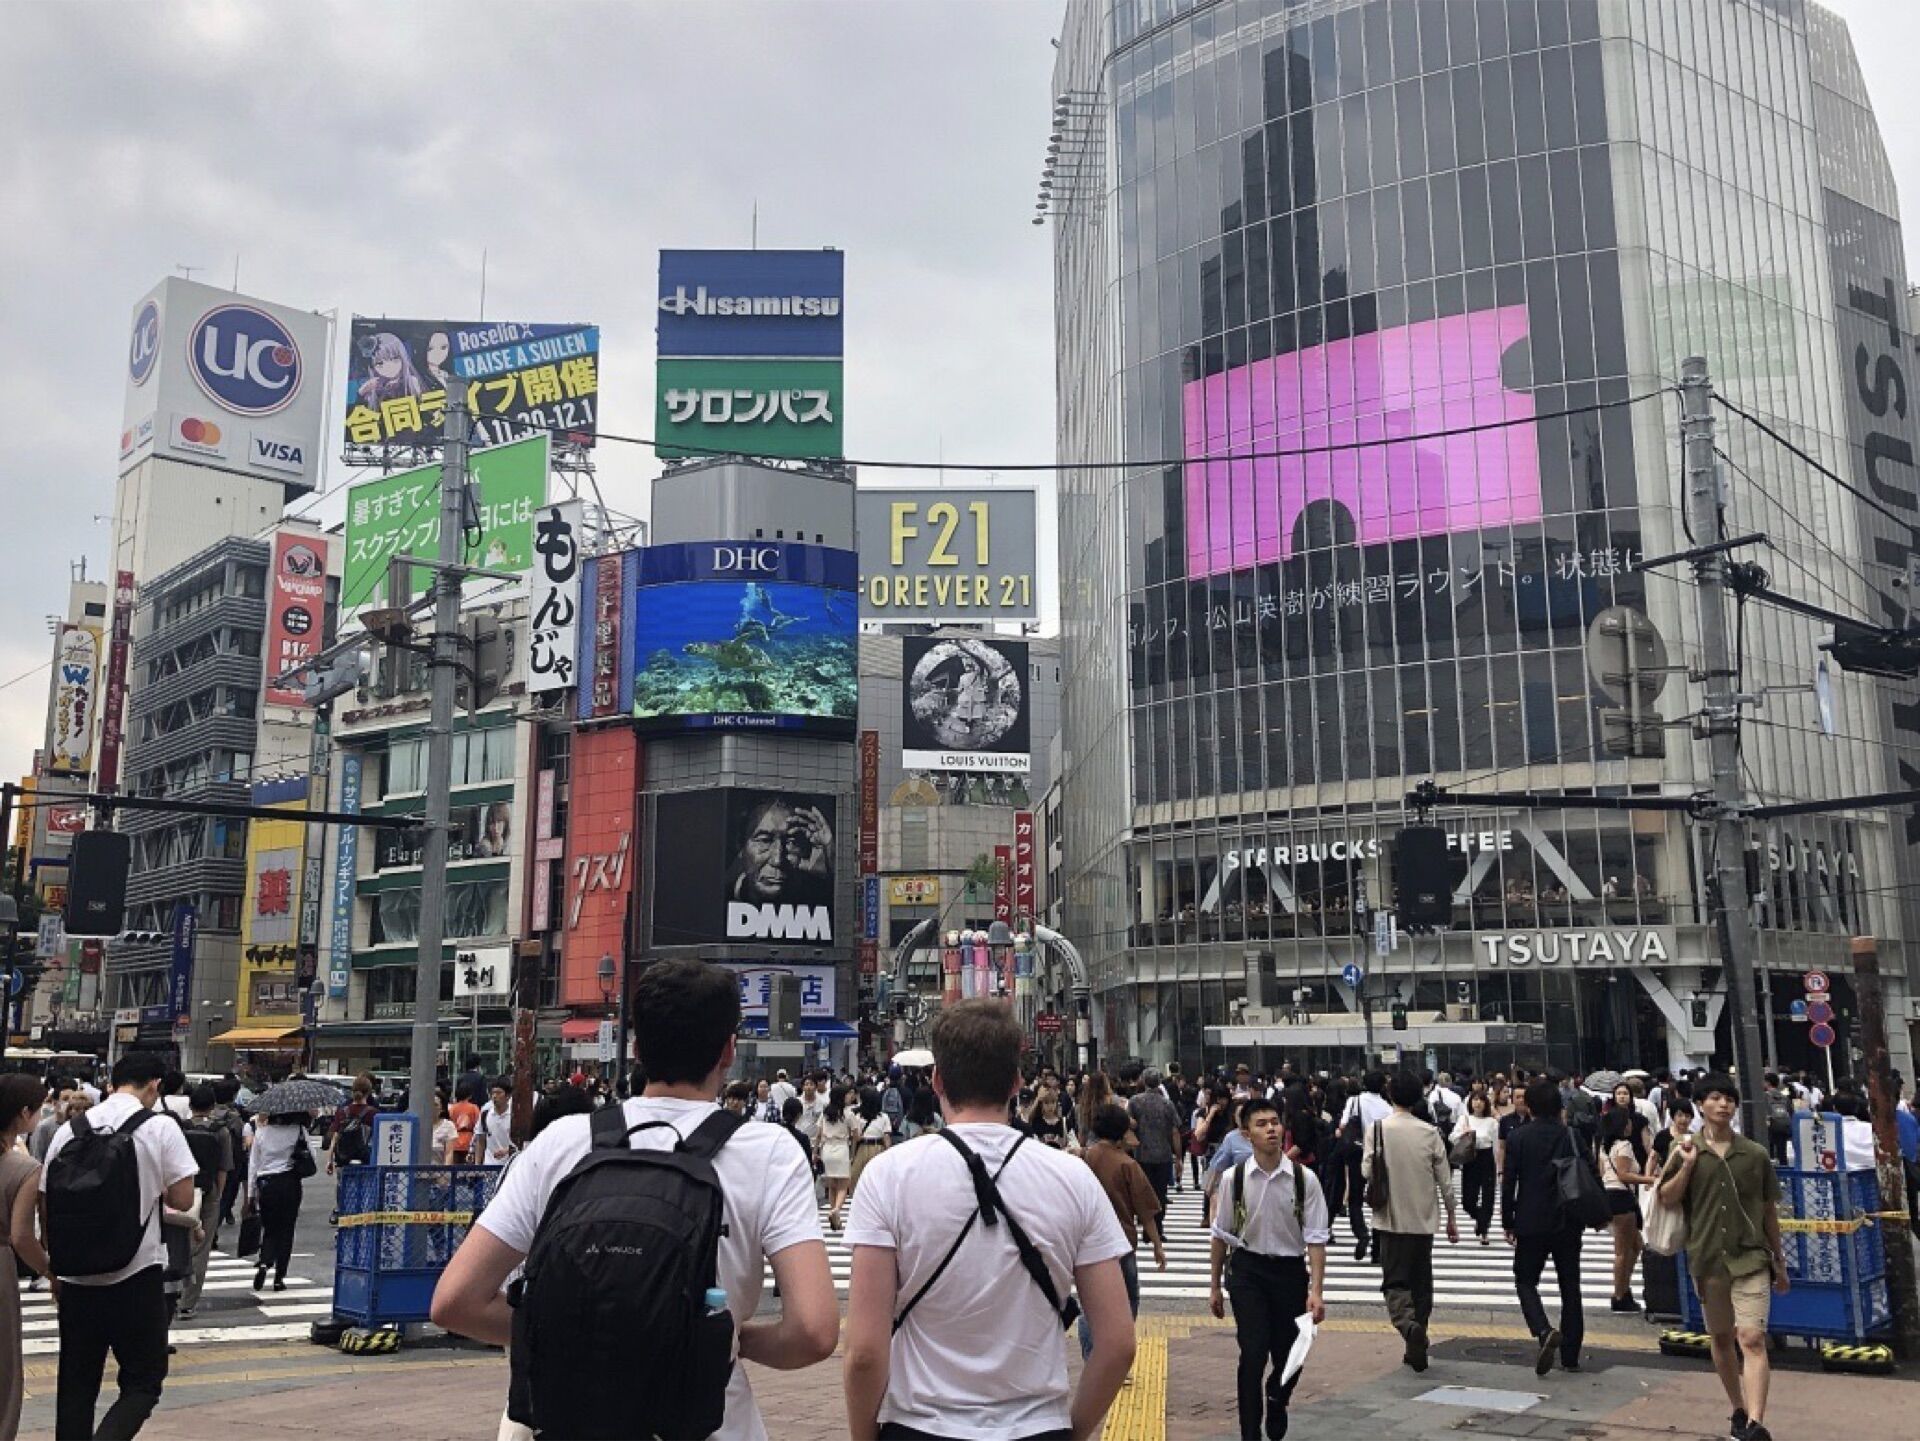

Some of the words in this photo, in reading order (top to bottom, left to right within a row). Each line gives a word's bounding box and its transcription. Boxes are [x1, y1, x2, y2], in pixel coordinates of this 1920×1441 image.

[659, 285, 841, 317] Hisamitsu
[456, 324, 520, 352] Roselia
[463, 349, 513, 378] RAISE
[516, 346, 529, 367] A
[527, 332, 588, 361] SUILEN
[664, 387, 834, 424] サロンパス
[256, 439, 304, 465] VISA
[890, 501, 990, 566] F21
[711, 547, 780, 572] DHC
[532, 506, 578, 684] もんじゃ
[999, 574, 1031, 607] 21
[712, 715, 735, 726] DHC
[736, 715, 776, 726] Channel
[940, 755, 976, 767] LOUIS
[978, 756, 1028, 768] VUITTON
[1226, 839, 1383, 870] STARBUCKS
[1445, 830, 1514, 854] FFEE
[726, 900, 833, 941] DMM
[1480, 930, 1669, 966] TSUTAYA
